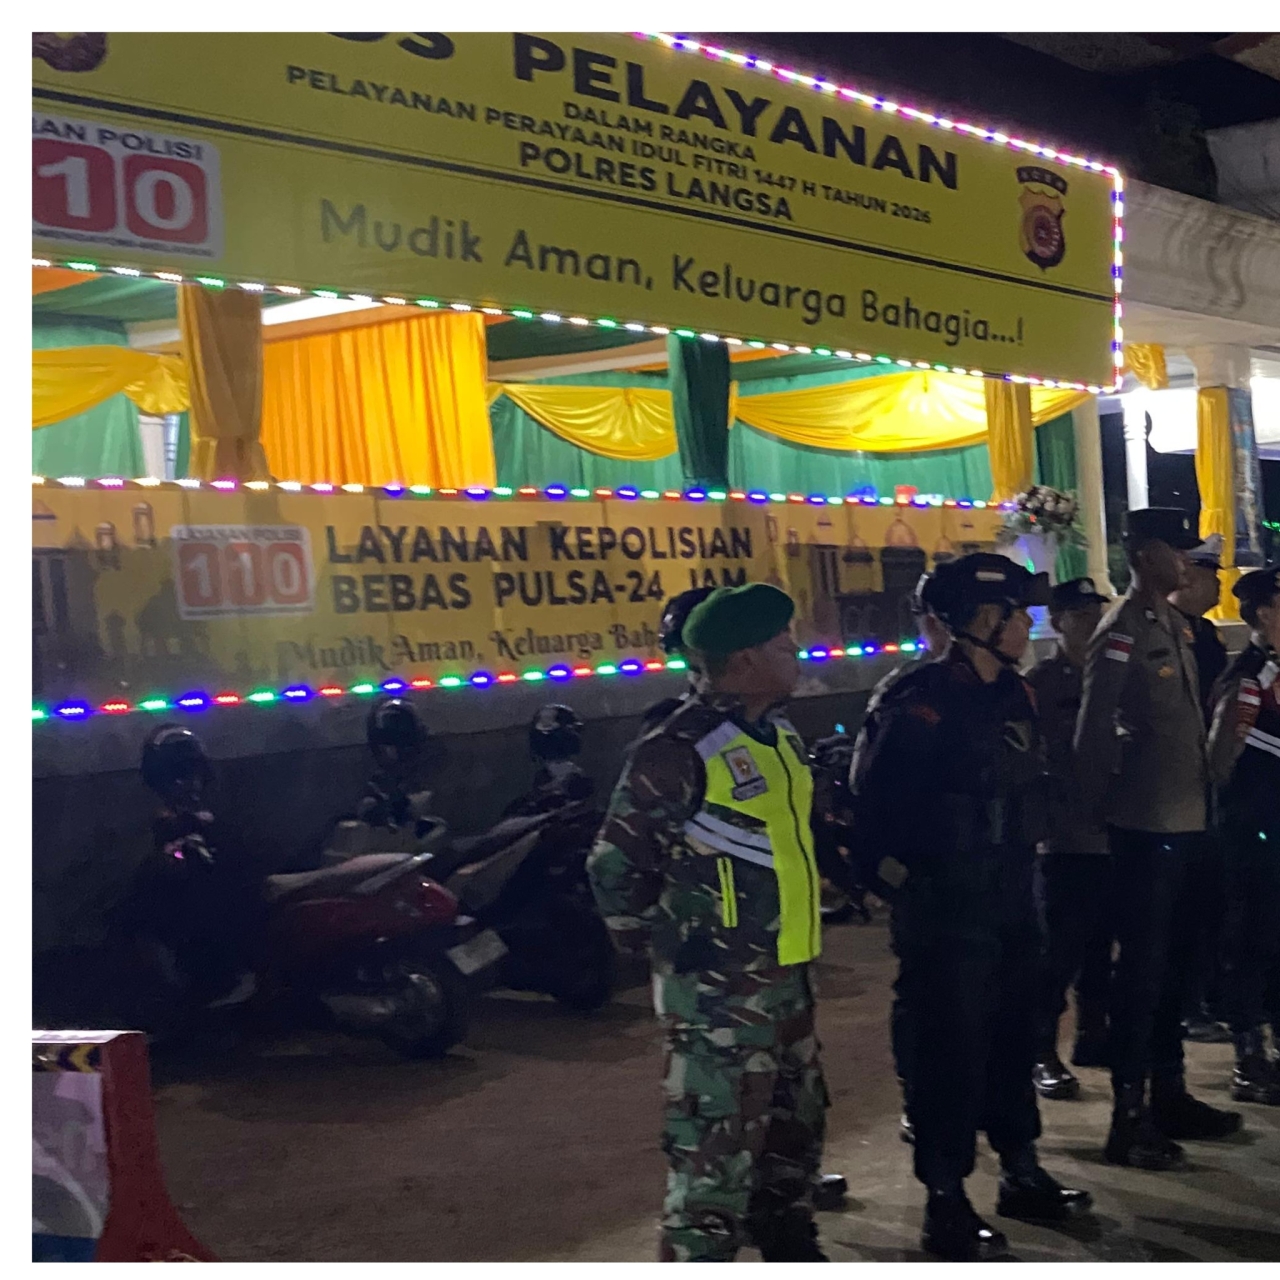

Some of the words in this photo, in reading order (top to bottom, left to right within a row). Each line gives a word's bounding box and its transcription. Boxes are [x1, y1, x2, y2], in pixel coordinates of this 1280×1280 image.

[514, 33, 958, 190] PELAYANAN
[563, 102, 653, 138] DALAM
[660, 124, 756, 162] RANGKA
[97, 128, 204, 160] POLISI
[286, 65, 476, 121] PELAYANAN
[485, 107, 625, 153] PERAYAAN
[632, 139, 687, 167] IDUL
[693, 154, 748, 181] FITRI
[753, 169, 798, 192] 1447
[802, 180, 816, 197] H
[821, 185, 887, 213] TAHUN
[891, 203, 932, 224] 2026
[520, 142, 657, 191] POLRES
[667, 172, 793, 220] LANGSA
[320, 198, 483, 263] Mudik
[505, 229, 654, 290] Aman,
[672, 254, 846, 325] Keluarga
[325, 525, 528, 563] LAYANAN
[549, 526, 753, 560] KEPOLISIAN
[184, 550, 301, 598] 110
[332, 572, 472, 614] BEBAS
[494, 569, 665, 607] PULSA-24
[488, 627, 603, 660] Keluarga
